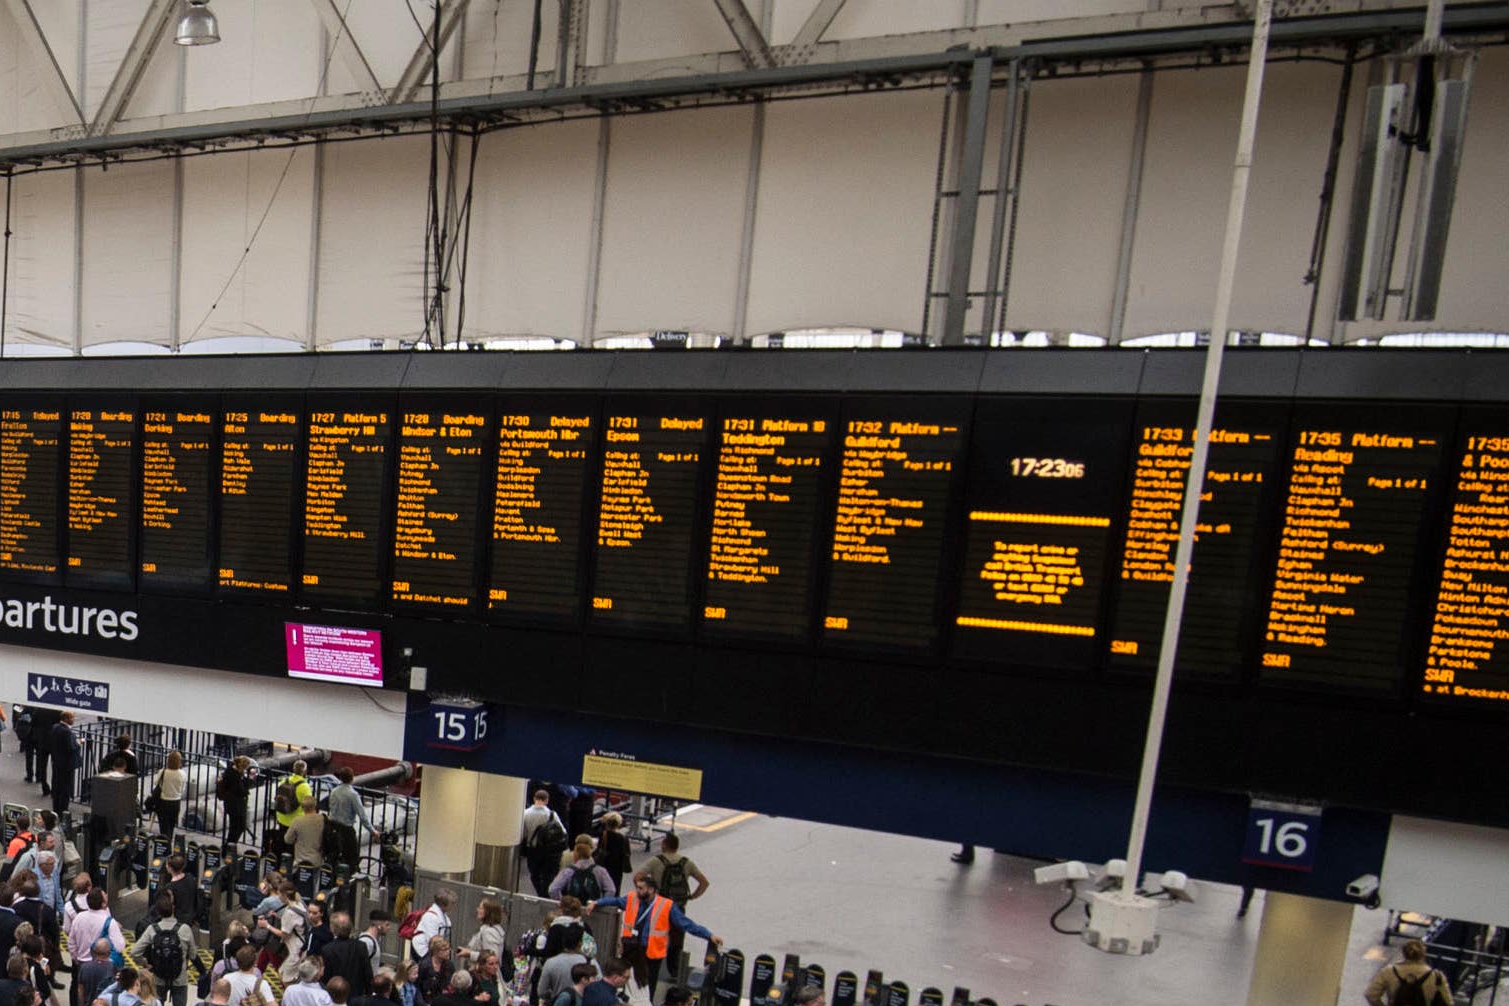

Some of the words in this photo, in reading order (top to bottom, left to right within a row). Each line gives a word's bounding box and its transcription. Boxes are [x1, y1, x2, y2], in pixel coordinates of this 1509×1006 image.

[101, 412, 132, 421] Boarding
[146, 413, 165, 421] 17:24
[177, 413, 210, 423] Boarding
[227, 413, 247, 421] 17:25
[260, 413, 295, 423] Boarding
[312, 414, 334, 422] 17:27
[344, 414, 377, 423] Platform
[405, 414, 429, 424] 17:28
[443, 415, 484, 426] Boarding
[503, 416, 529, 426] 17:30
[551, 417, 589, 427] Delayed
[145, 424, 172, 433] Dorking
[610, 417, 637, 428] 17:31
[661, 418, 703, 429] Delayed
[725, 419, 754, 430] 17:31
[762, 420, 808, 431] Platform
[849, 422, 882, 433] 17:32
[890, 422, 939, 434] Platform
[310, 425, 359, 435] Strawberry
[402, 427, 436, 436] Windsor
[450, 428, 471, 436] Eton
[501, 429, 557, 439] Portsmouth
[561, 430, 579, 440] Hbr
[1144, 428, 1183, 440] 17:33
[607, 430, 639, 442] Epsom
[723, 433, 785, 445] Teddington
[1301, 432, 1341, 445] 17:35
[1352, 434, 1413, 448] Platform
[845, 436, 900, 448] Guildford
[1139, 444, 1194, 456] Guildfor
[1295, 448, 1353, 464] Reading
[1368, 477, 1392, 488] Page
[303, 575, 318, 584] SWR
[393, 582, 409, 591] SWR
[489, 590, 506, 600] SWR
[593, 598, 612, 608] SWR
[705, 607, 726, 618] SWR
[825, 617, 848, 629] SWR
[1111, 641, 1137, 654] SWR
[1263, 654, 1290, 667] SWR
[1425, 669, 1454, 682] SWR
[65, 697, 78, 705] Wide
[79, 699, 91, 707] gate
[435, 711, 466, 741] 15
[474, 711, 487, 739] 15
[599, 750, 619, 758] Penalty
[1255, 817, 1308, 857] 16
